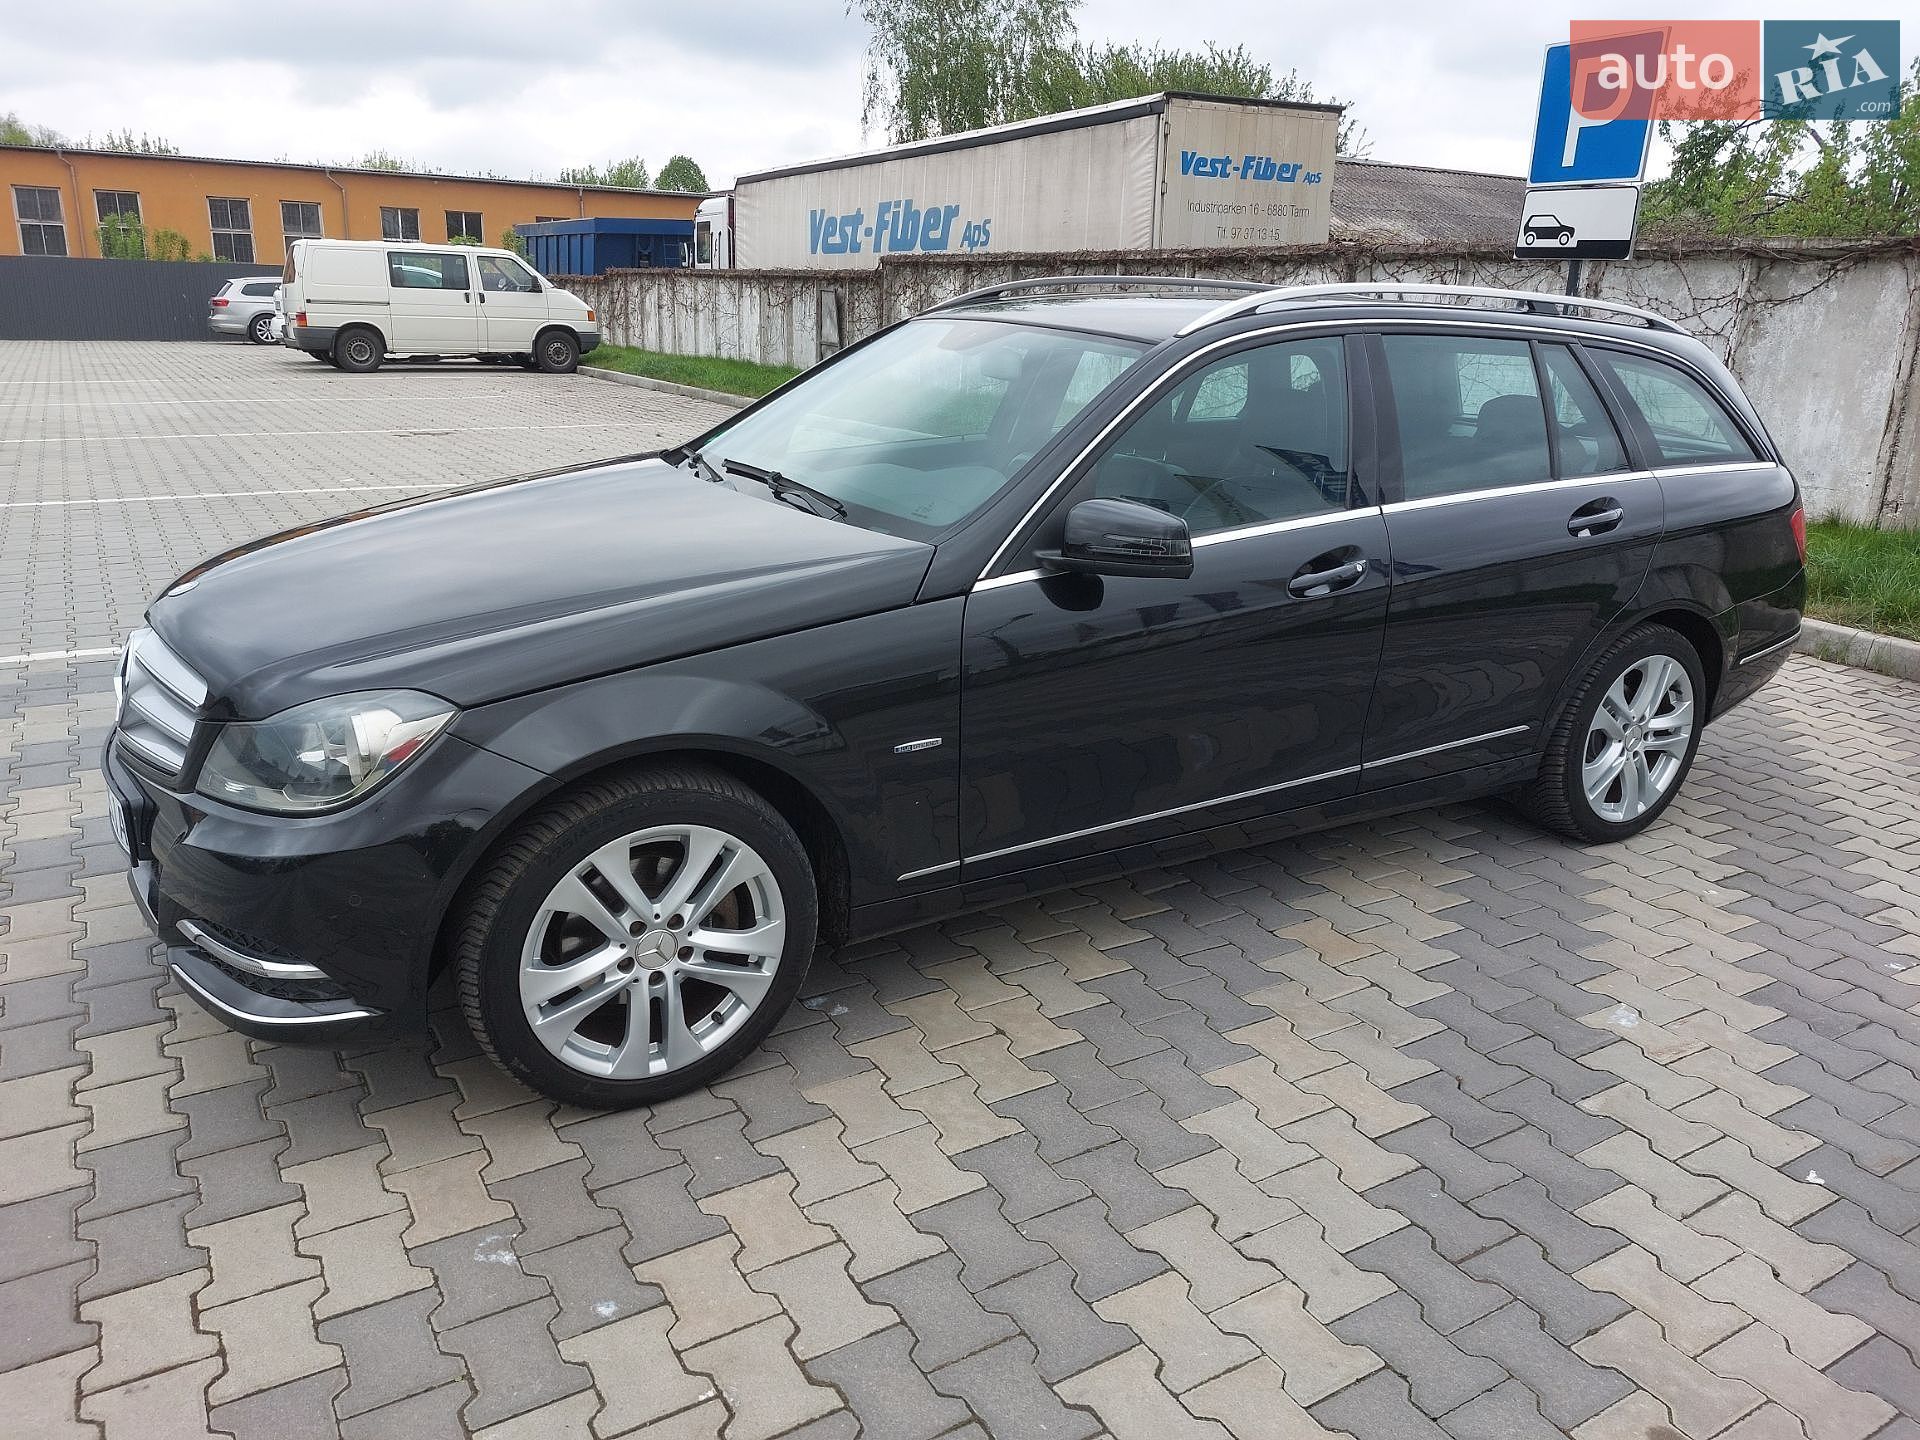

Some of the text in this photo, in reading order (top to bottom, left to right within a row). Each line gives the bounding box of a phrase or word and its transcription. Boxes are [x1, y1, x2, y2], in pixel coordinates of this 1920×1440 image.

[1561, 56, 1634, 168] P
[1302, 171, 1323, 185] ApS
[1187, 200, 1247, 217] Industriparken
